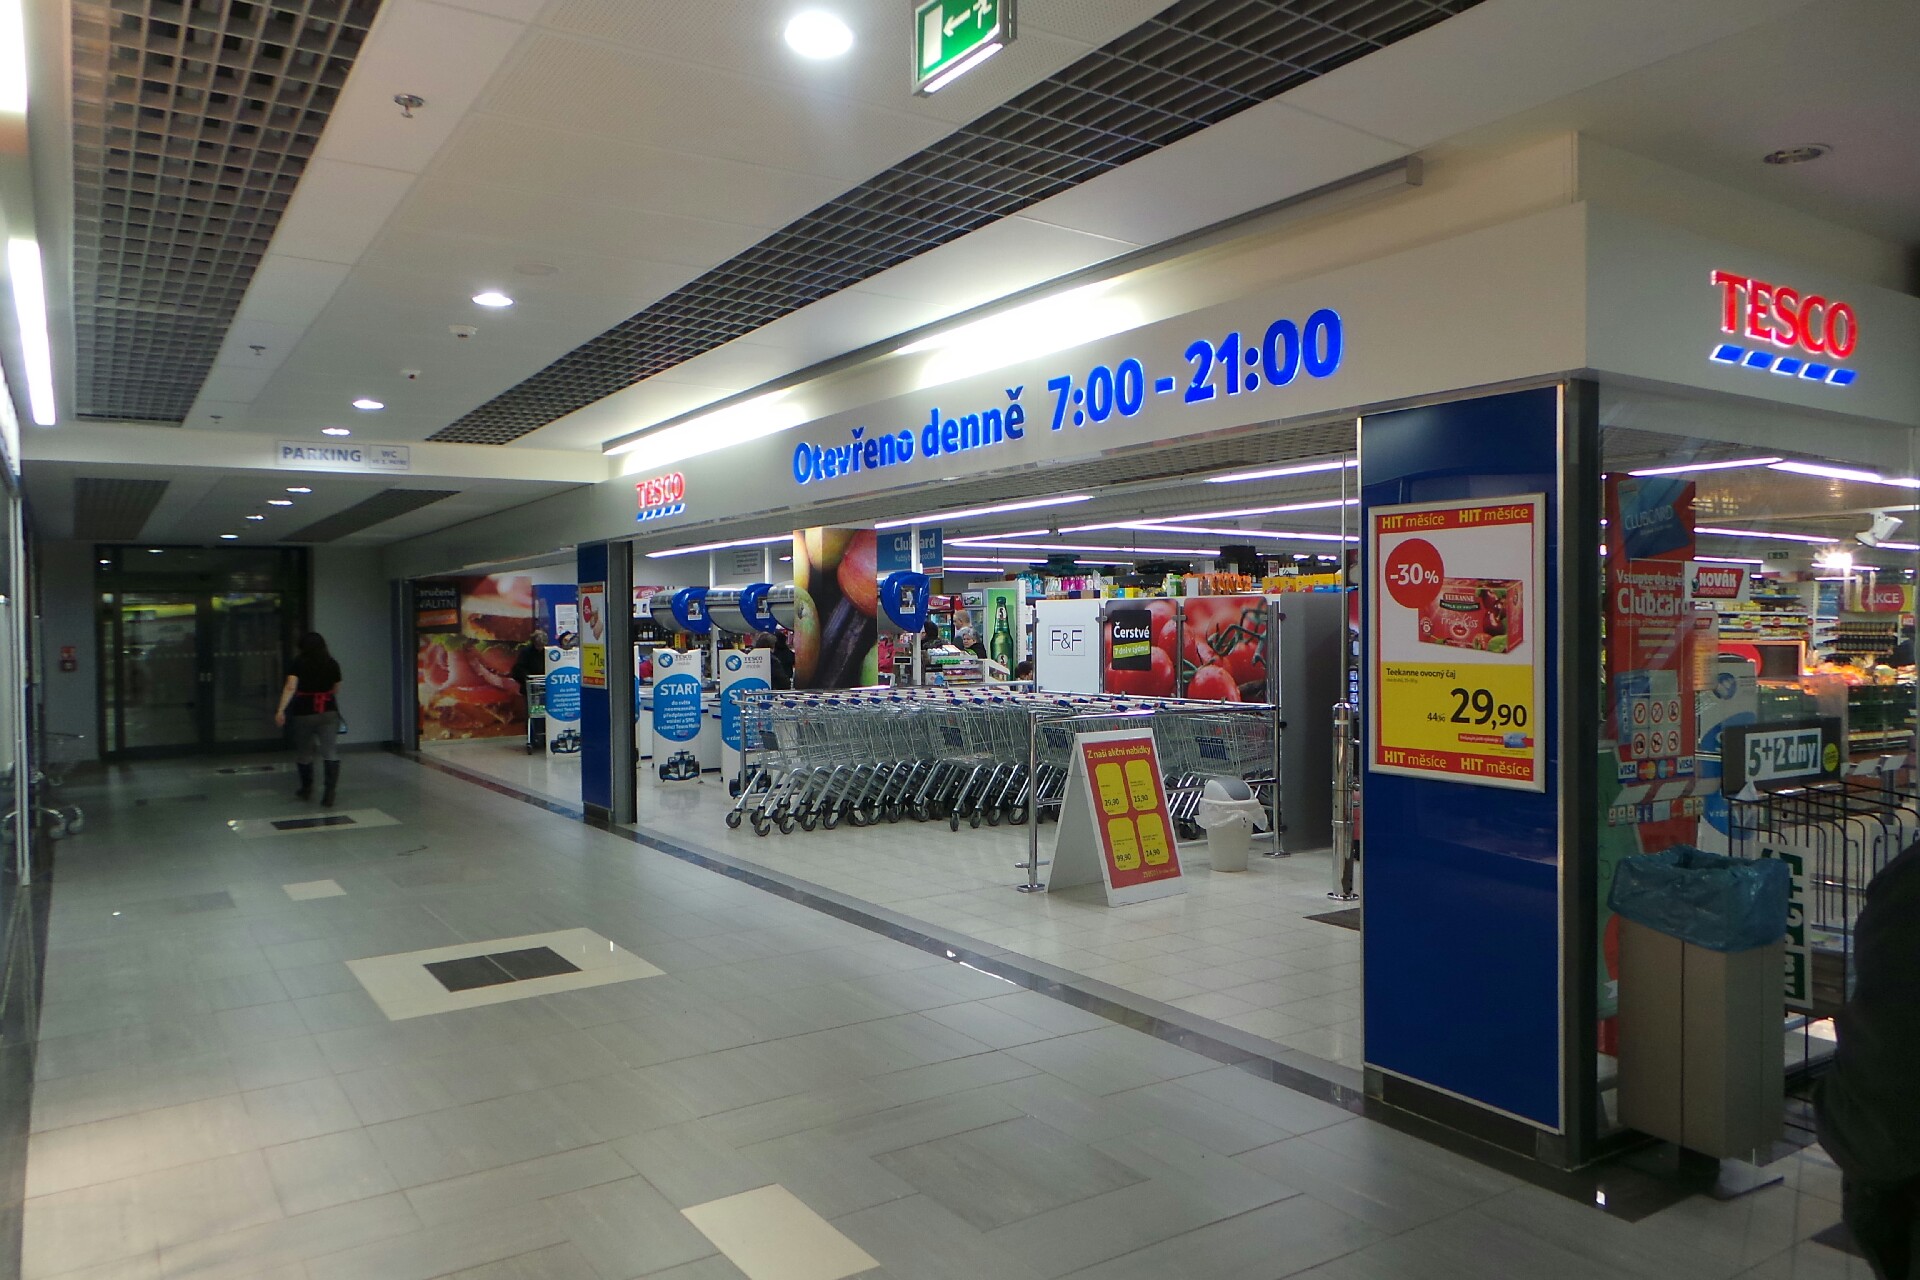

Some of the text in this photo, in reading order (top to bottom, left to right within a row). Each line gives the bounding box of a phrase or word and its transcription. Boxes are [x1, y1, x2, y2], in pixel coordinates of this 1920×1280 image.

[1711, 270, 1858, 360] TESCO
[793, 308, 1344, 485] Otevřeno denně 7:00 - 21:00
[282, 446, 361, 462] PARKING
[381, 450, 397, 458] WC
[635, 472, 686, 508] TESCO
[1382, 506, 1529, 529] HIT měsíce HIT měsíce
[1699, 570, 1737, 588] NOVÁK
[1113, 622, 1150, 639] Čerstvé
[1051, 629, 1082, 652] F&F
[550, 673, 580, 685] STAR
[1386, 668, 1456, 679] Teekanne ovocný čaj
[660, 682, 698, 696] START
[1450, 687, 1528, 730] 29,90
[1087, 750, 1093, 759] Z
[1108, 747, 1126, 757] akční
[1126, 745, 1151, 756] nabídky
[1384, 750, 1531, 777] HIT měsíce HIT měsíce
[1620, 764, 1635, 775] VISA
[1679, 759, 1693, 769] VISA
